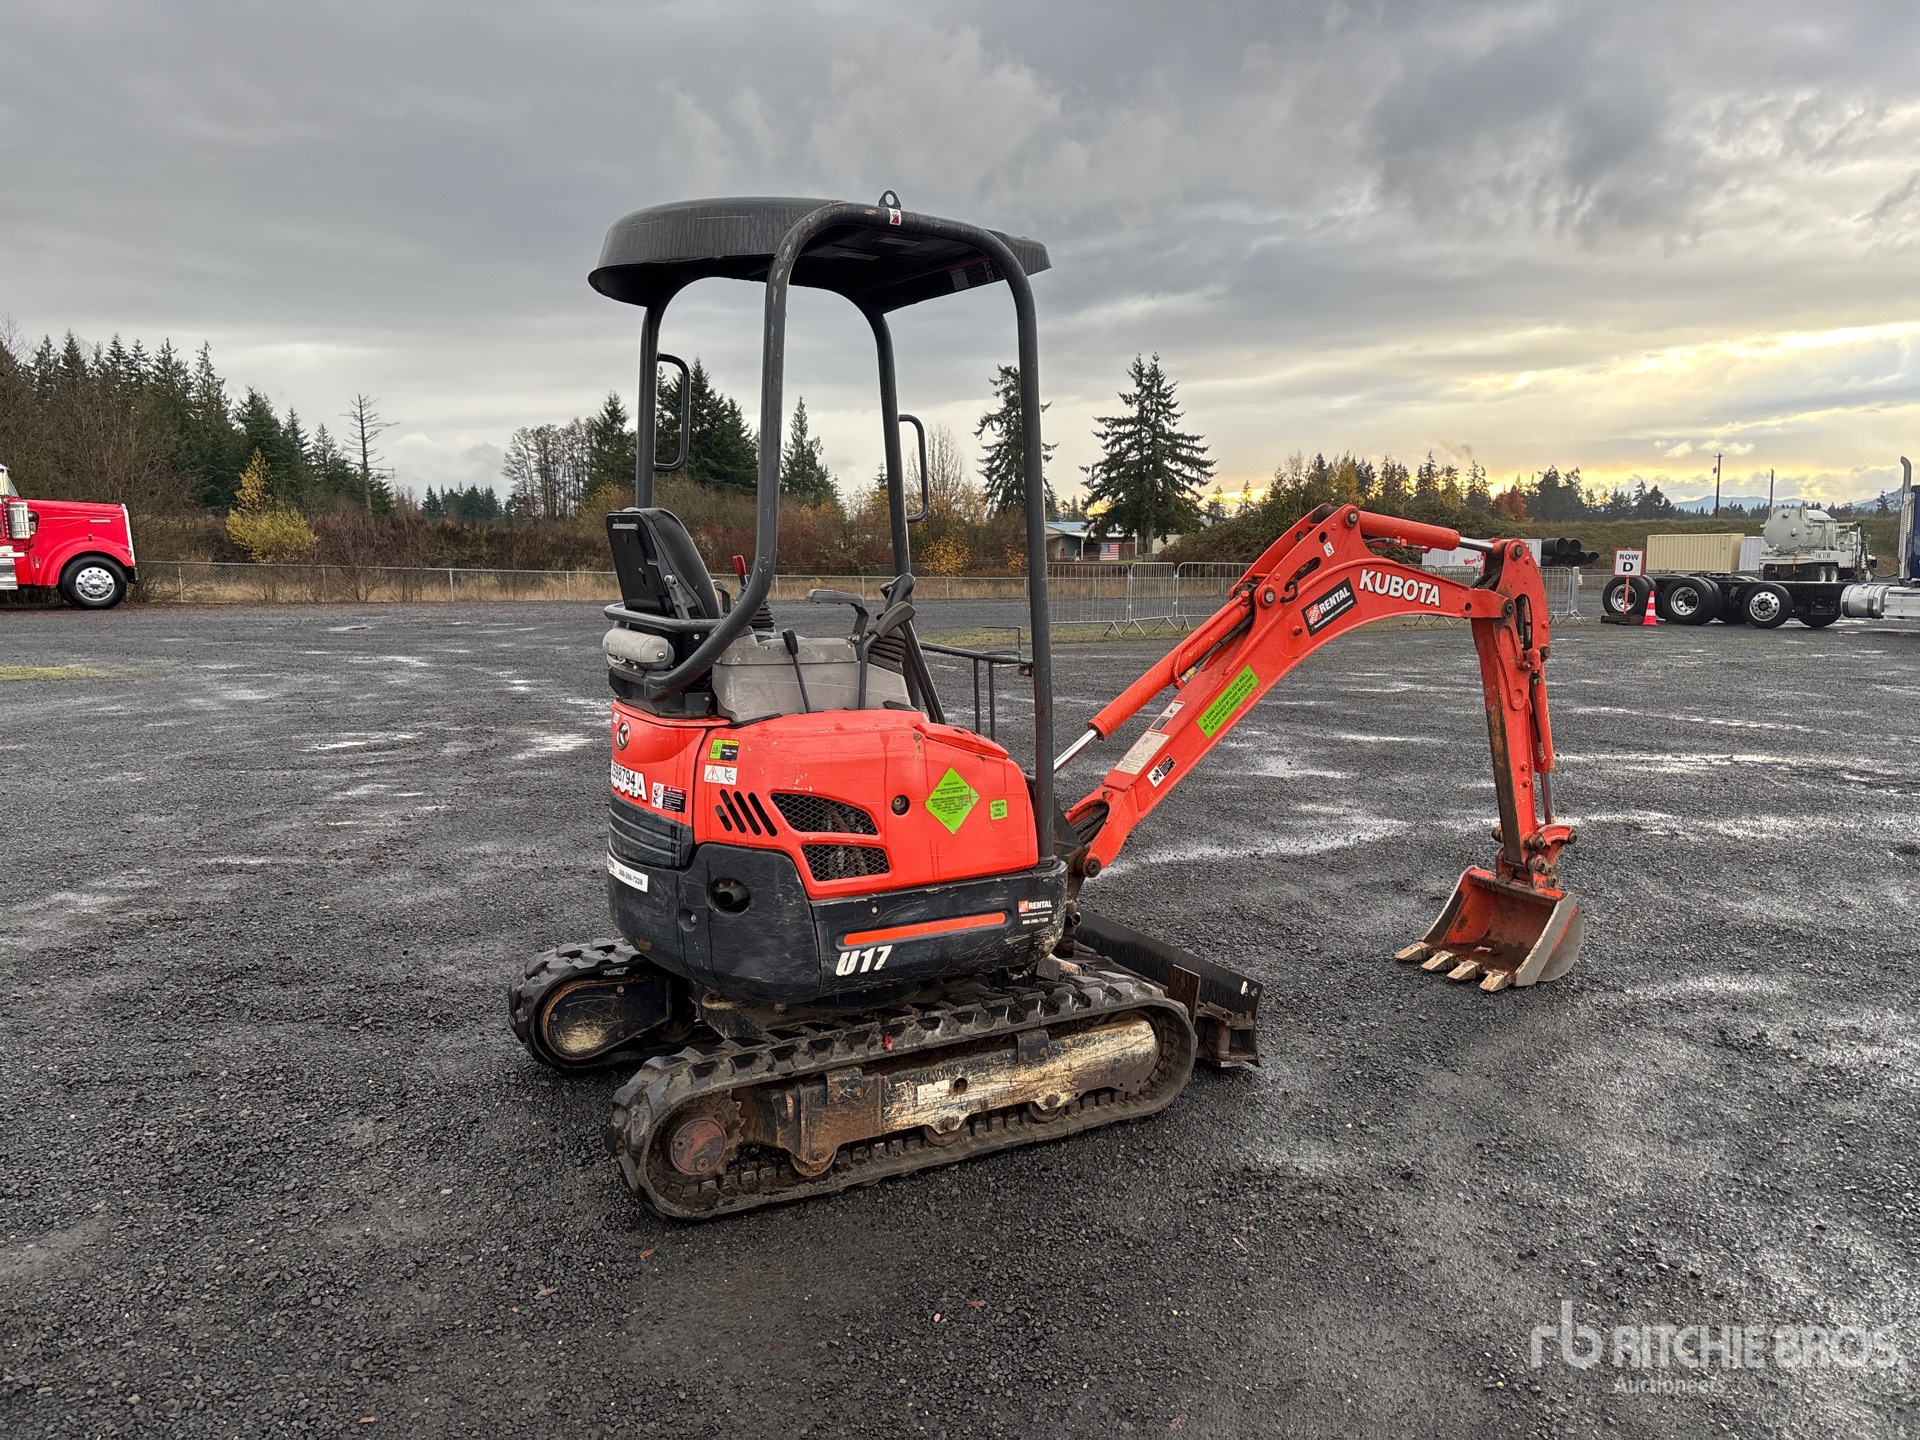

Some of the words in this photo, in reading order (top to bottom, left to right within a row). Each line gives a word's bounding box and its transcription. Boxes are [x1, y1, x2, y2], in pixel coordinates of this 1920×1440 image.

[1622, 562, 1634, 572] D
[1318, 586, 1351, 614] RENTAL
[1358, 568, 1440, 607] KUBOTA
[1028, 900, 1052, 910] RENTAL
[835, 944, 893, 977] U17
